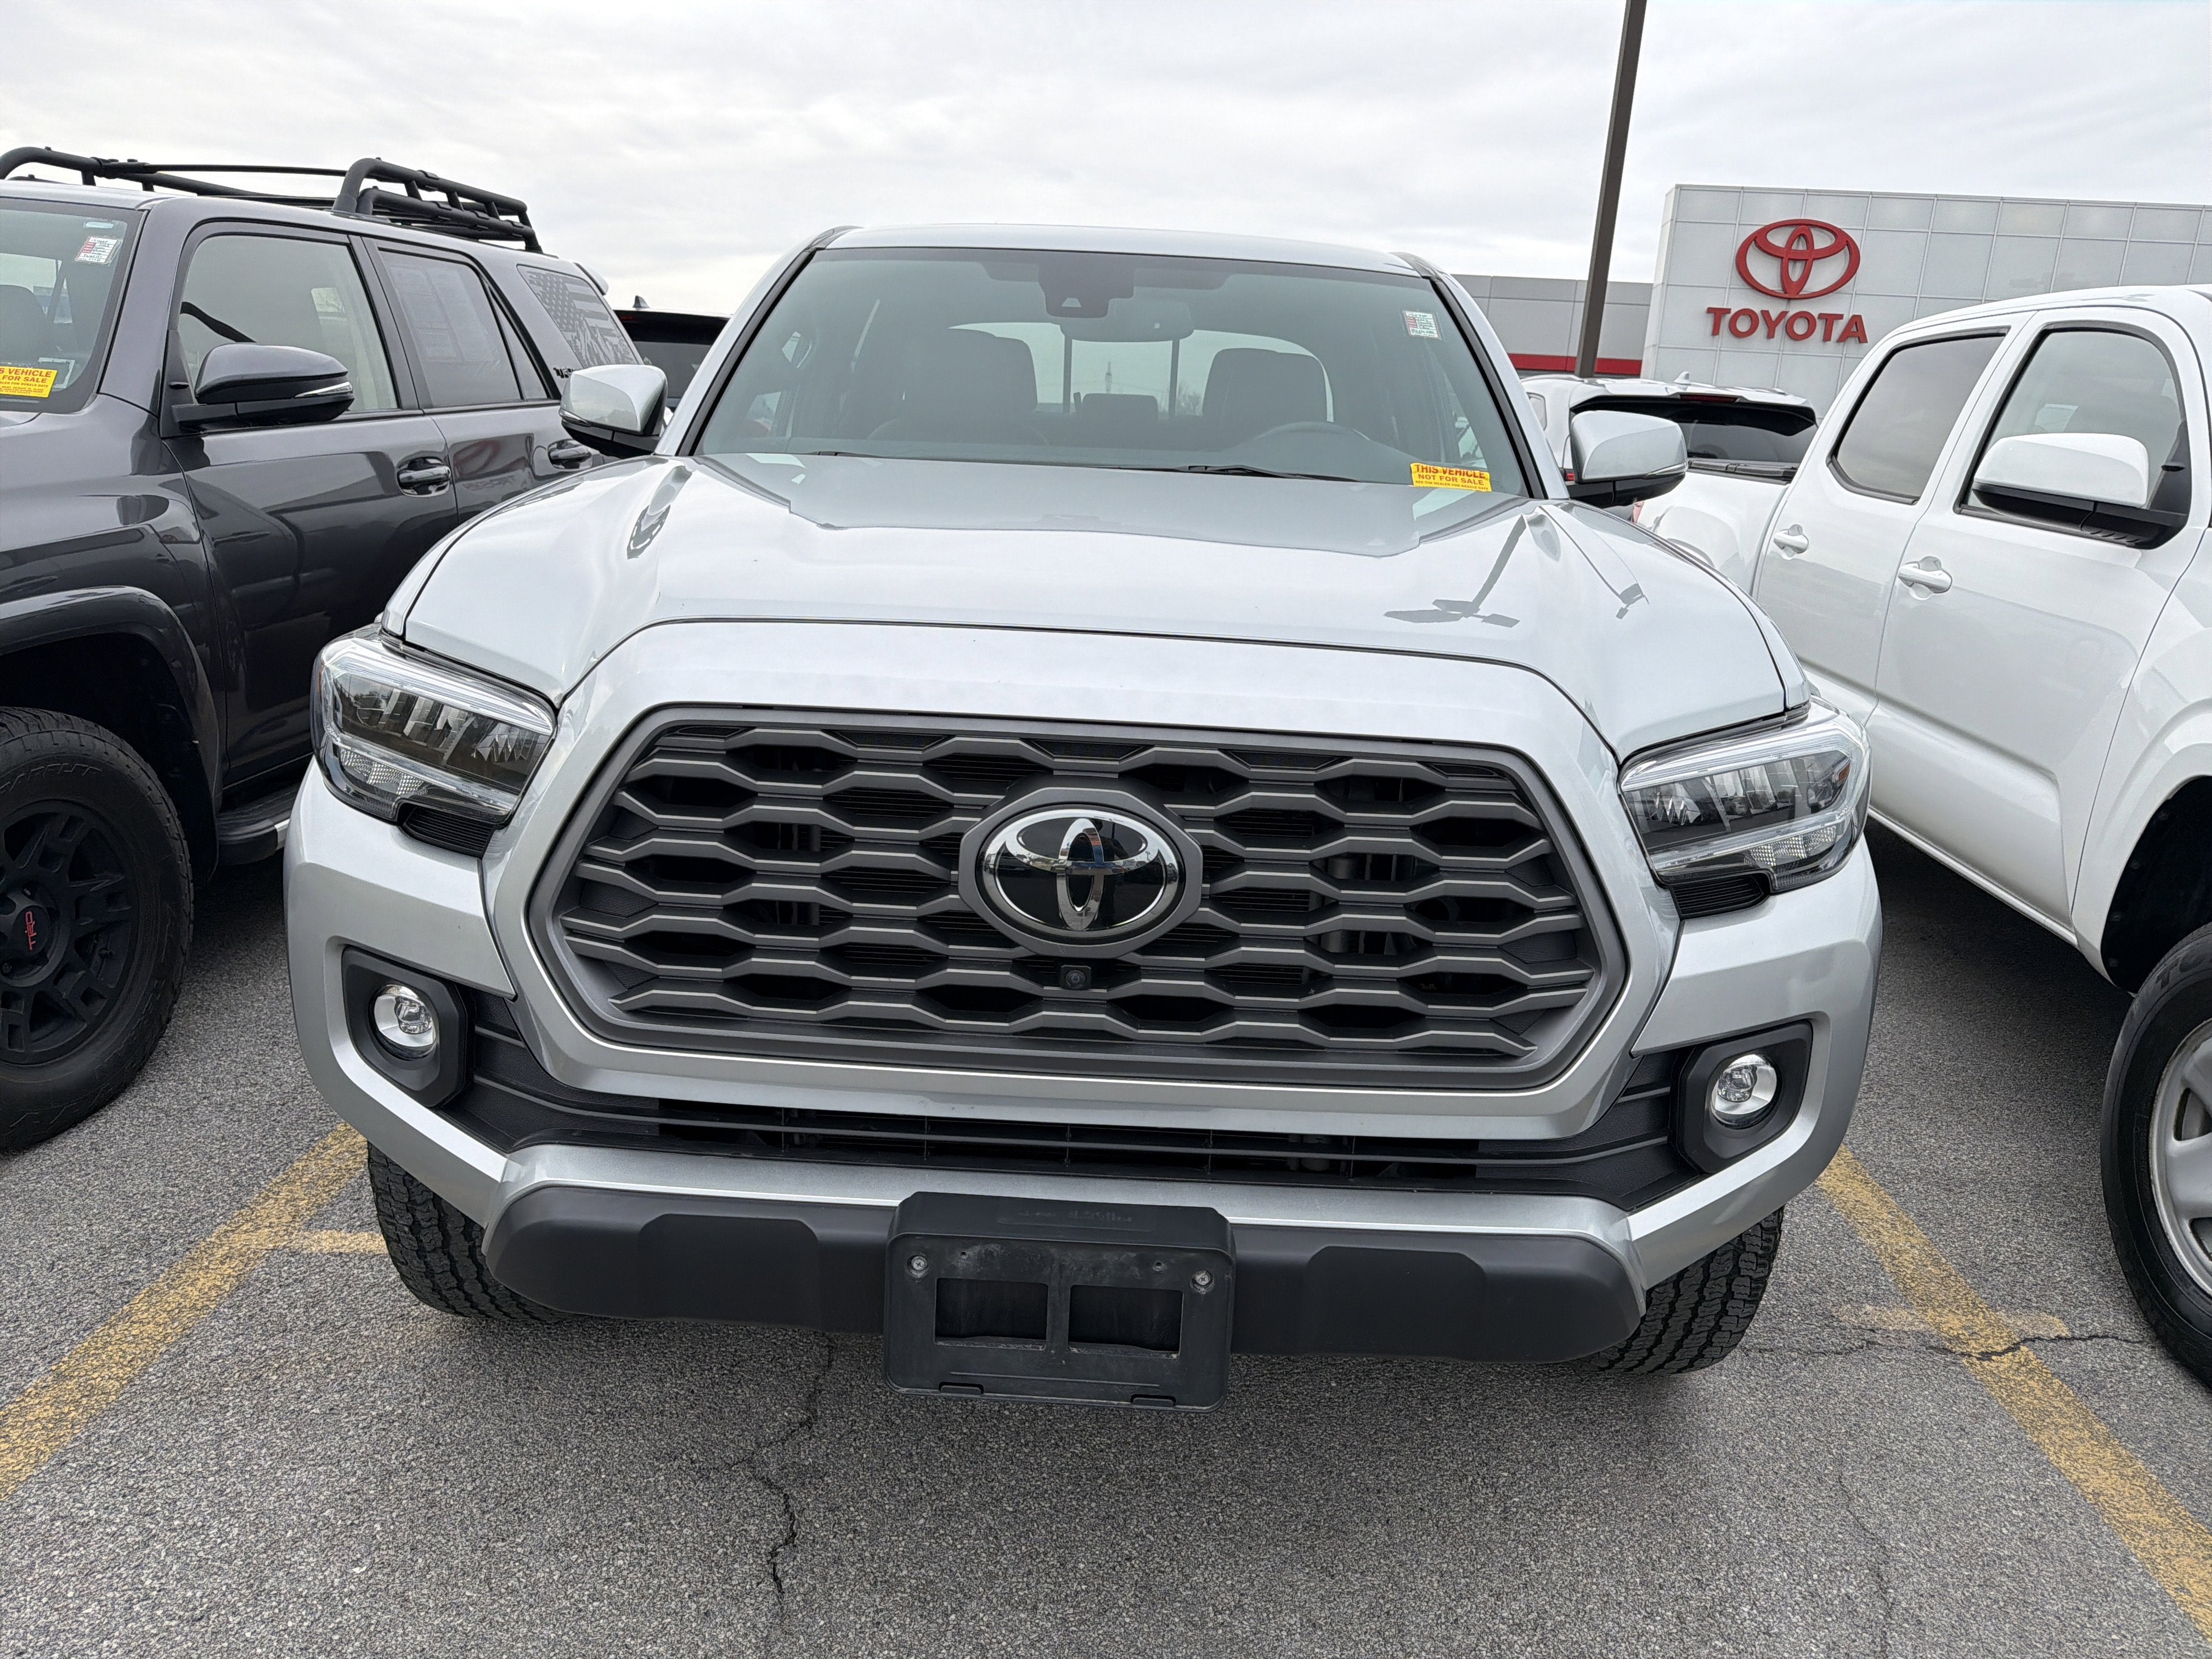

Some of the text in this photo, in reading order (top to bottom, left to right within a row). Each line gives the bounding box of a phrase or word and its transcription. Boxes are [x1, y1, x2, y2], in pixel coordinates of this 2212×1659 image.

[1706, 307, 1868, 343] TOYOTA
[8, 369, 52, 377] VEHICLE
[1415, 464, 1486, 479] THIS VEHICLE
[25, 911, 37, 951] TRD
